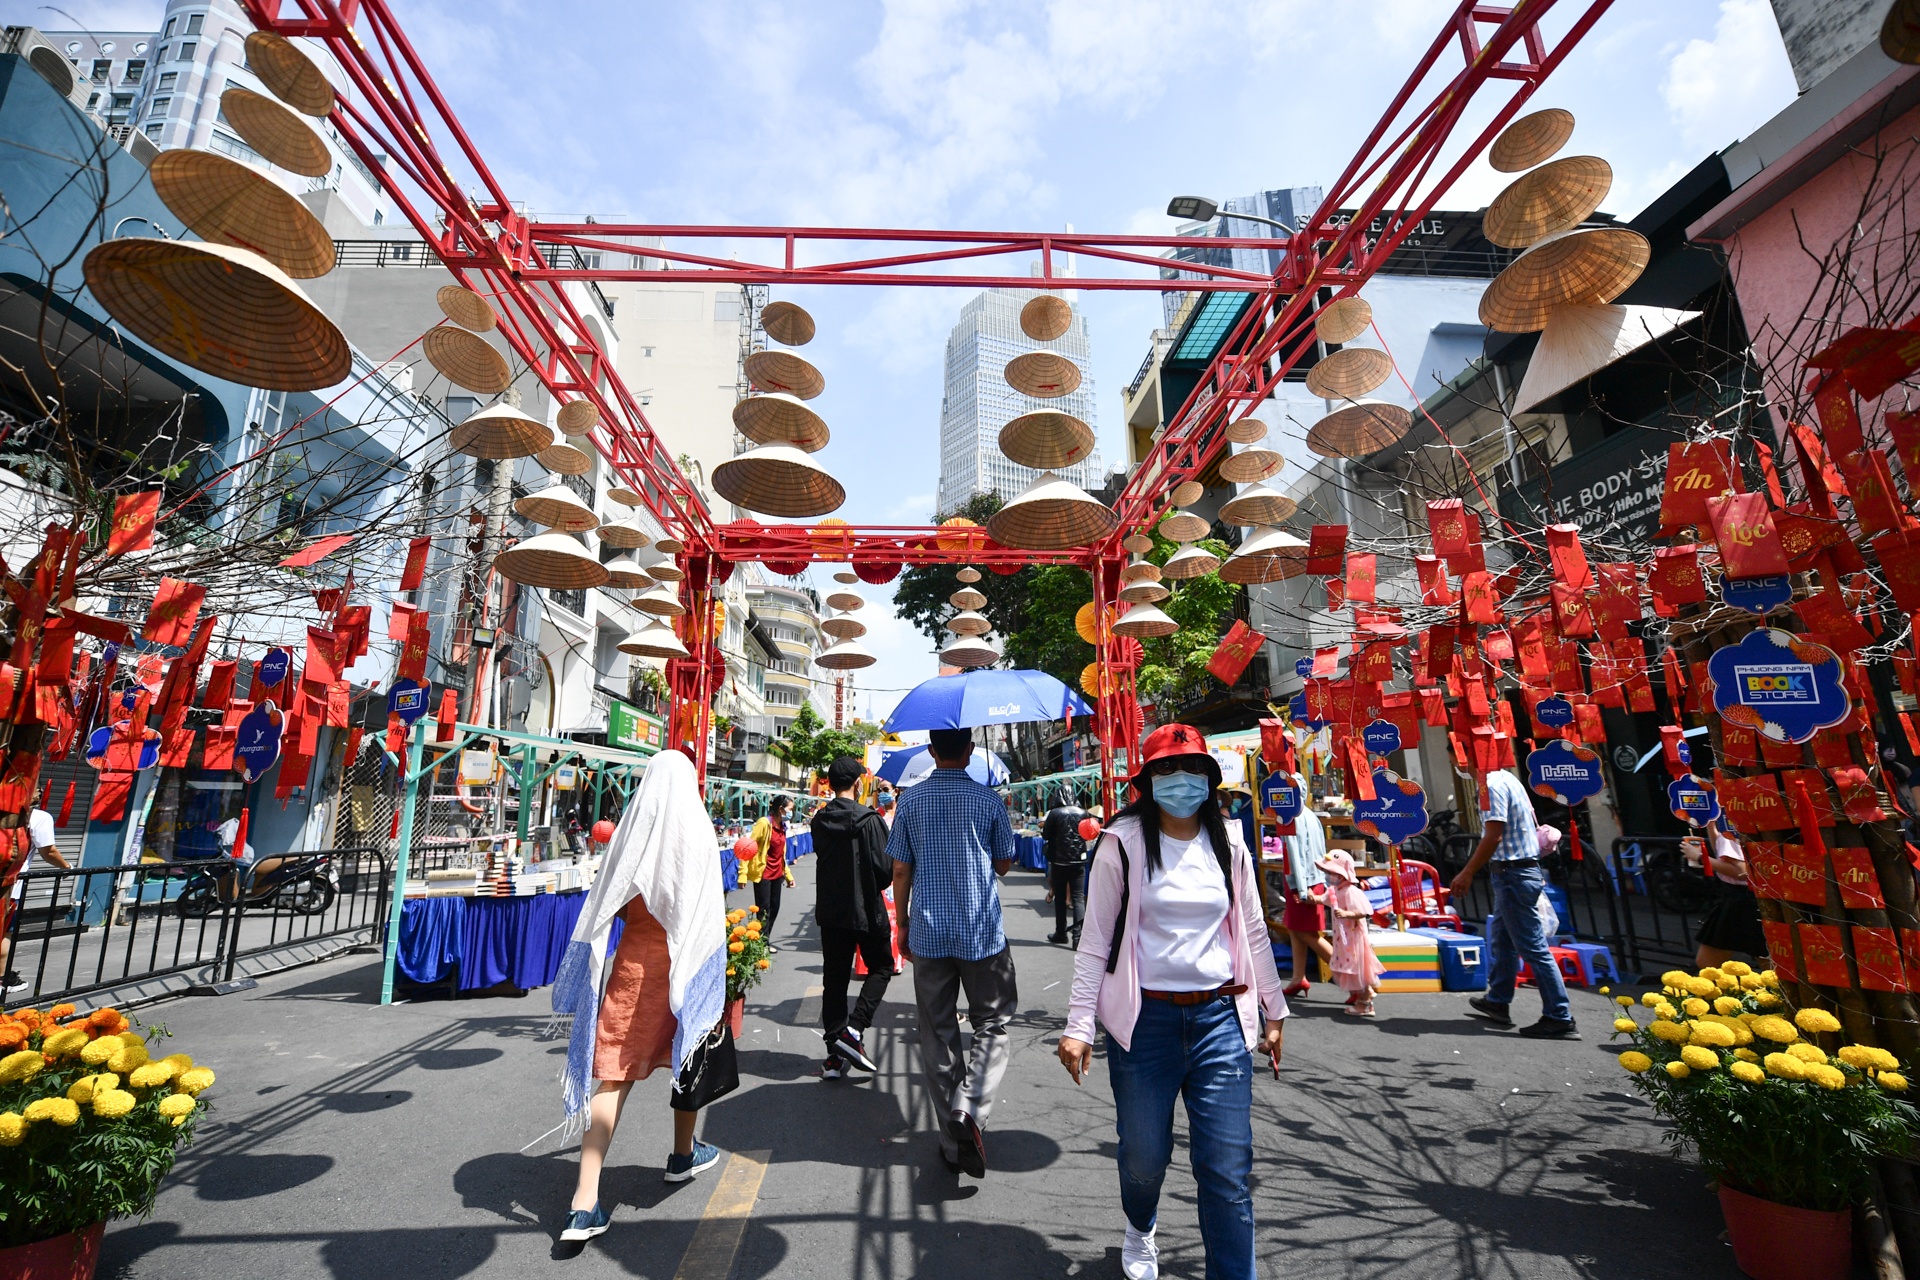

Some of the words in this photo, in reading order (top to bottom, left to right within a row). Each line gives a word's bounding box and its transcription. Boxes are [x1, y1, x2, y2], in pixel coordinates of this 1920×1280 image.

[1673, 467, 1714, 492] An
[1539, 496, 1575, 525] THE
[1580, 467, 1632, 508] BODY
[118, 513, 149, 531] Lộc
[1722, 520, 1769, 547] Lộc
[1730, 577, 1780, 591] PNC
[22, 618, 39, 642] Lộc
[1223, 642, 1247, 663] An
[1368, 652, 1386, 666] An
[263, 662, 284, 670] PNC
[1747, 675, 1803, 691] BOOK
[399, 694, 418, 703] BOOK
[1750, 690, 1808, 700] STORE
[331, 701, 346, 712] Lộc
[988, 703, 1020, 716] ELCOM
[1367, 705, 1382, 719] Lộc
[1726, 730, 1749, 744] An
[1750, 793, 1777, 810] An
[1788, 865, 1819, 883] Lộc
[1841, 867, 1872, 884] An
[1769, 940, 1789, 958] An
[1807, 945, 1838, 965] Lộc
[1862, 948, 1895, 966] An
